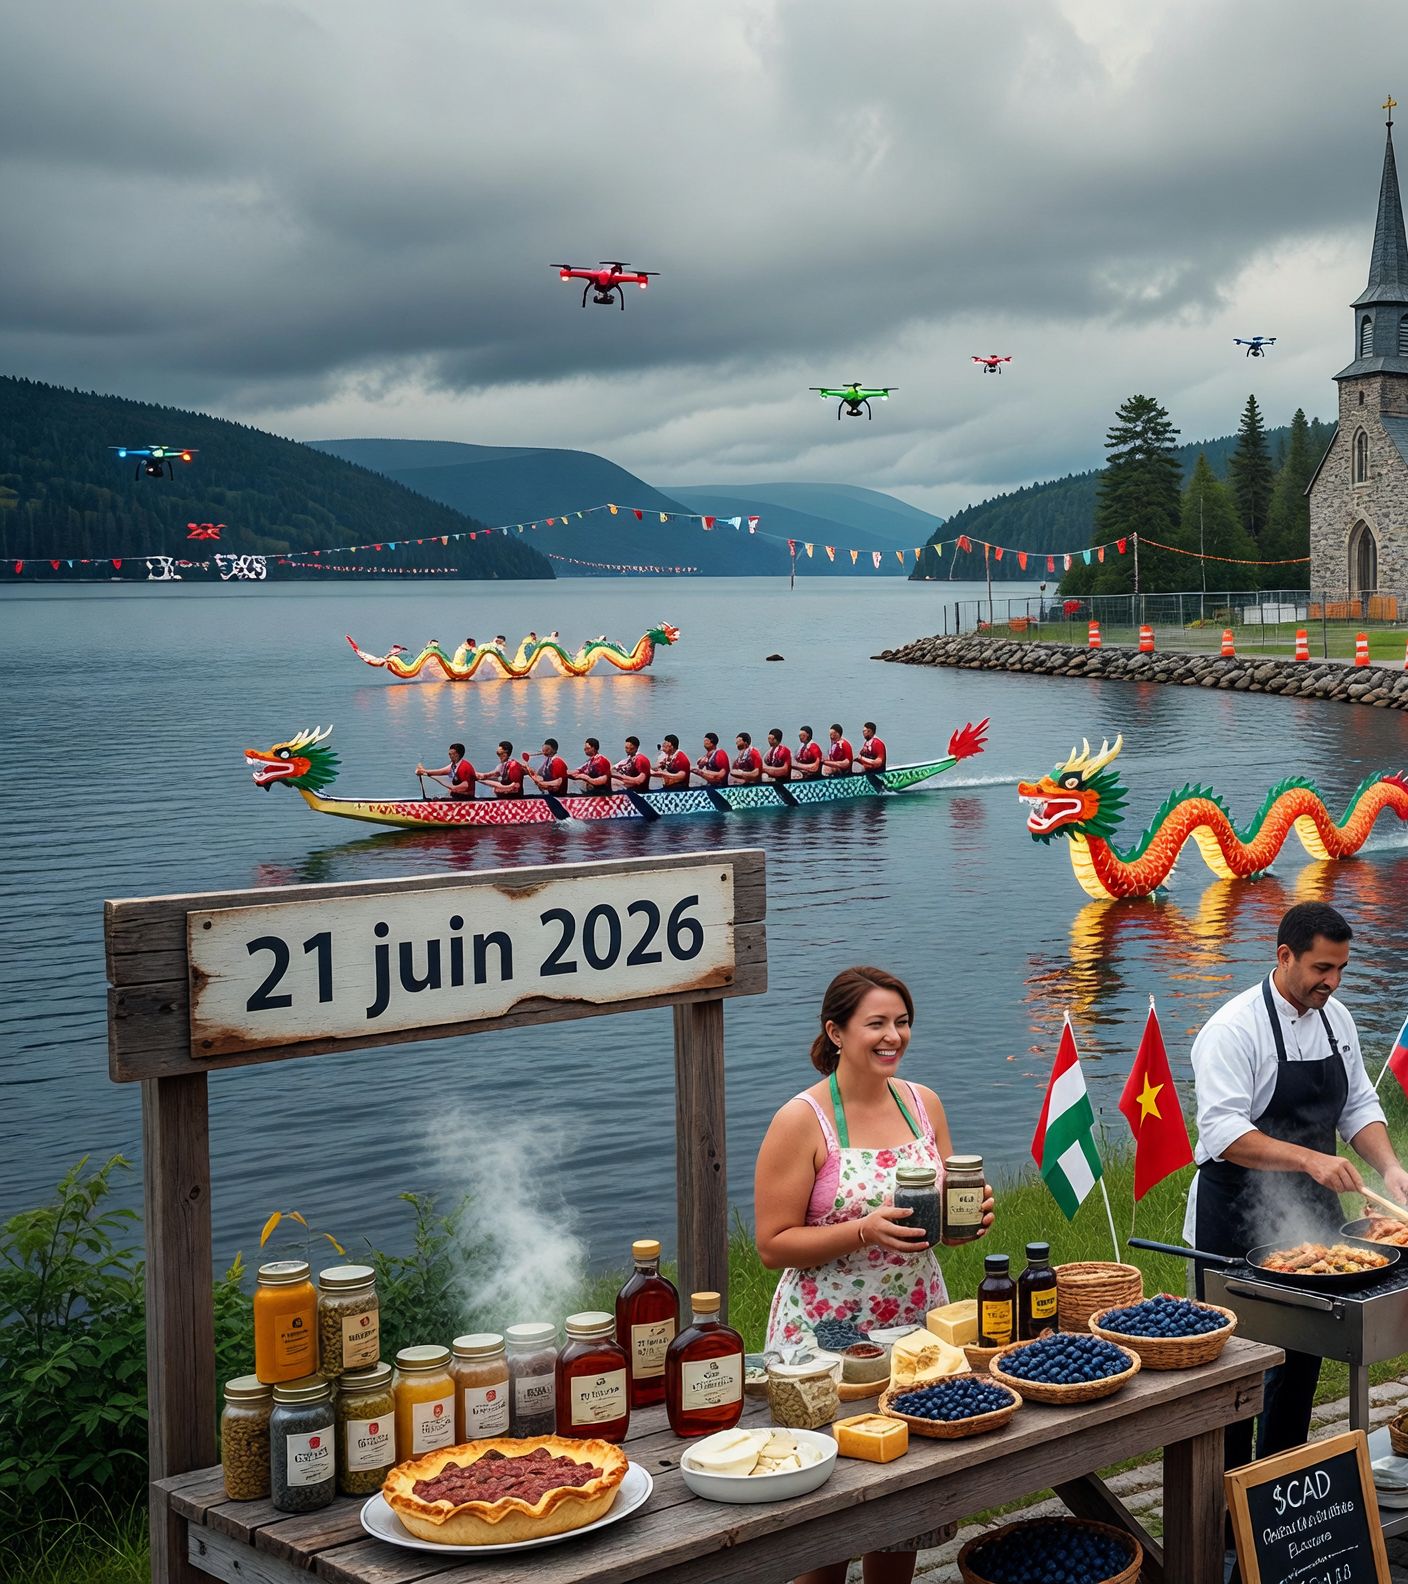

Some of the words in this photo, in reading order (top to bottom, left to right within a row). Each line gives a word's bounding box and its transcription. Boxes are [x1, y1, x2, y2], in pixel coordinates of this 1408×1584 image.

[245, 931, 333, 1012] 21
[365, 915, 512, 1019] juin
[539, 895, 703, 977] 2026
[1272, 1470, 1331, 1516] $CAD
